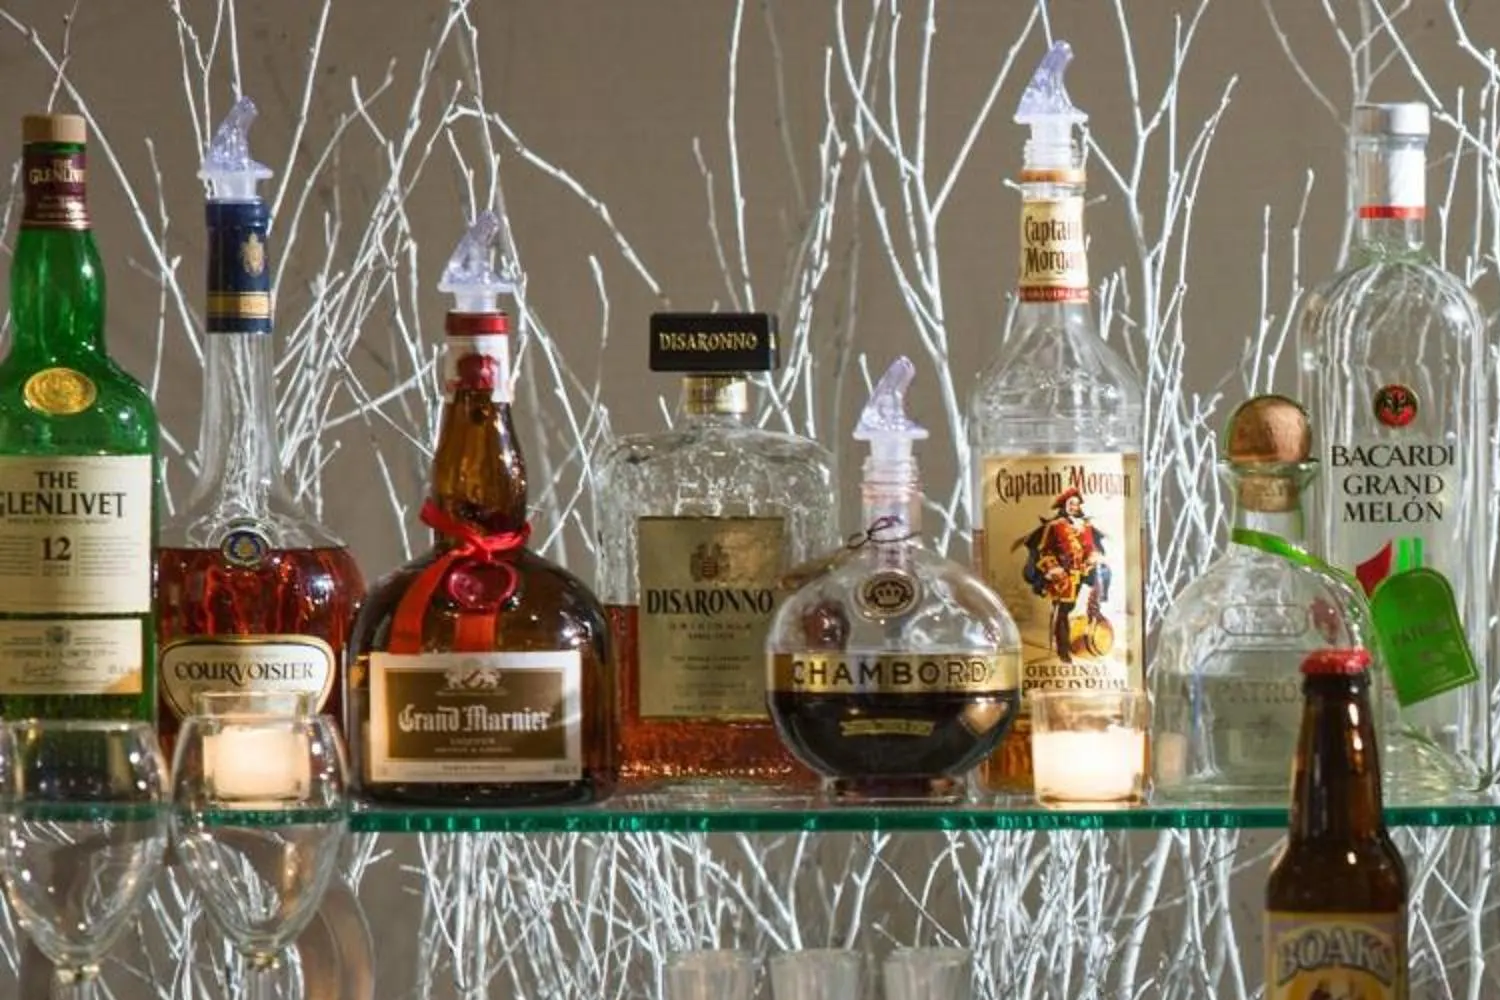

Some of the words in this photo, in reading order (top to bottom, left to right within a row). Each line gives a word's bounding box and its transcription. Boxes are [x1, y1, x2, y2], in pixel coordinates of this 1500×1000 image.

[1024, 215, 1080, 246] Captai
[659, 331, 758, 352] DISARONNO
[34, 470, 79, 489] THE
[995, 466, 1061, 503] Captain
[1062, 465, 1131, 500] Morgan
[1343, 473, 1444, 496] GRAND
[1343, 495, 1443, 523] MELÓN
[41, 535, 72, 561] 12
[646, 588, 774, 617] DISARONNO
[174, 660, 314, 687] COURVOISIER
[791, 660, 988, 686] CHAMBORD
[1214, 676, 1298, 704] PATRÓ
[398, 703, 460, 733] Grand
[461, 703, 551, 733] Marnier
